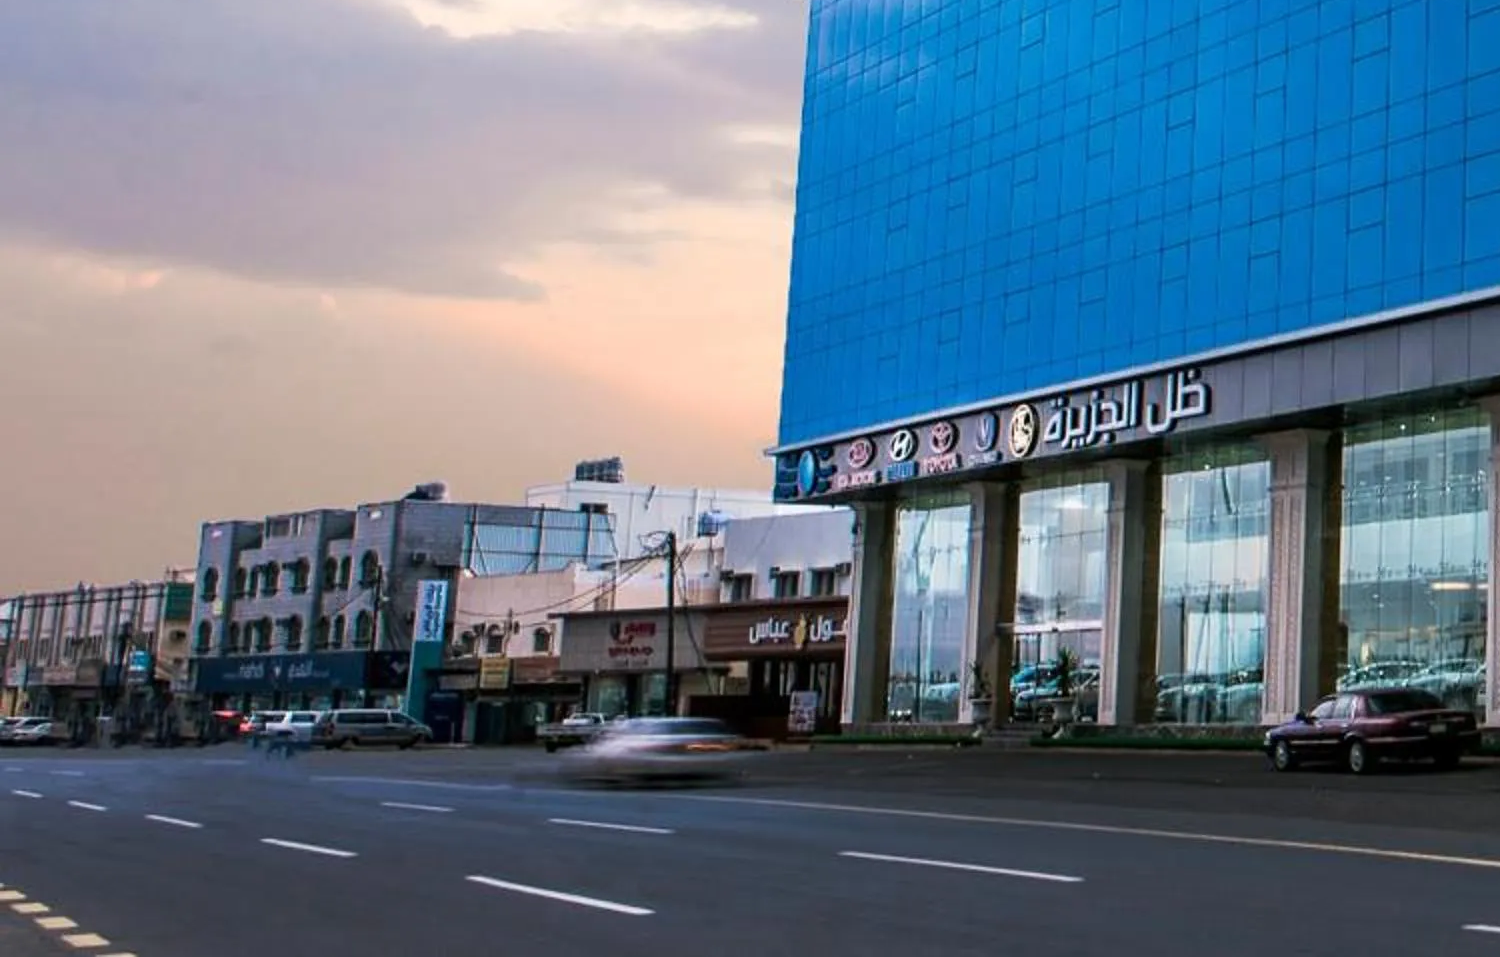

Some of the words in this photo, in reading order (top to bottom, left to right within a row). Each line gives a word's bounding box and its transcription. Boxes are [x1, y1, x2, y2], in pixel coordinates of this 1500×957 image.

[1043, 380, 1140, 448] الجزيرة
[1147, 369, 1207, 434] ظل
[749, 617, 790, 644] عباس
